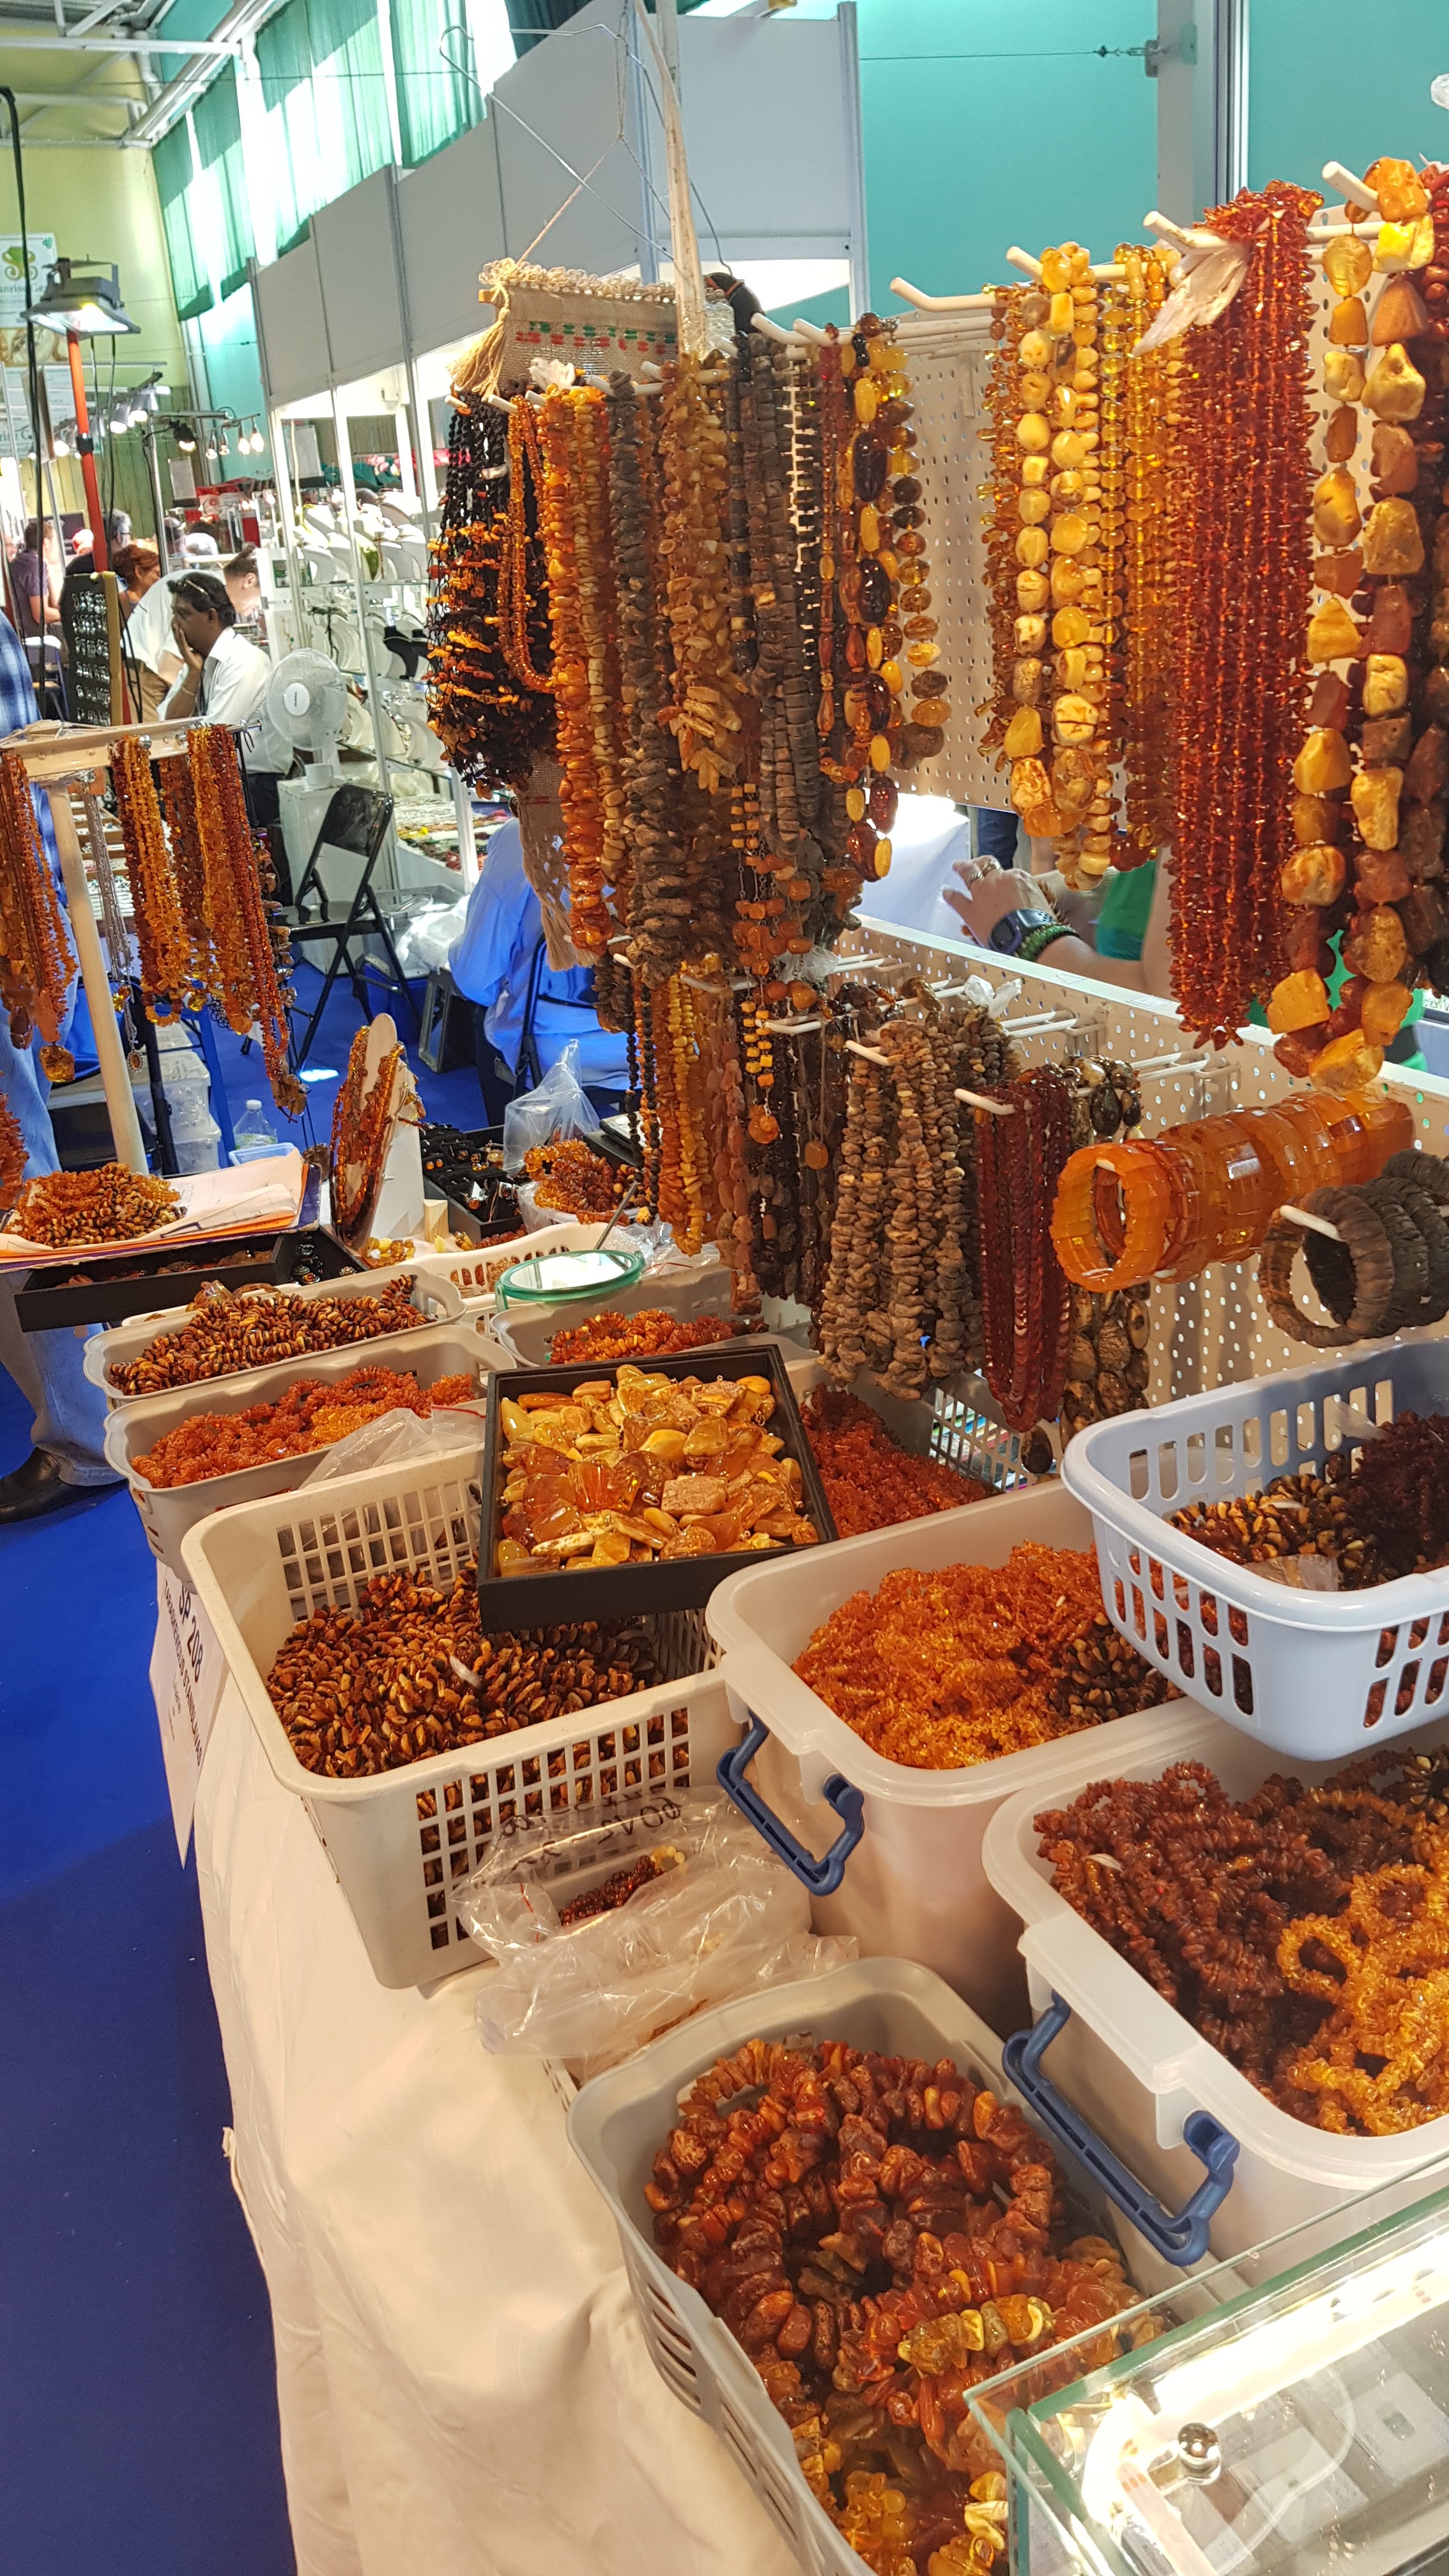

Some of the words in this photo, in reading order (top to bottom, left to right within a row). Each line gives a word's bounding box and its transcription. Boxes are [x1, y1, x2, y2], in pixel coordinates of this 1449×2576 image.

[179, 1584, 191, 1625] SP
[187, 1614, 203, 1683] 208
[183, 1669, 203, 1767] STANISLAVAS
